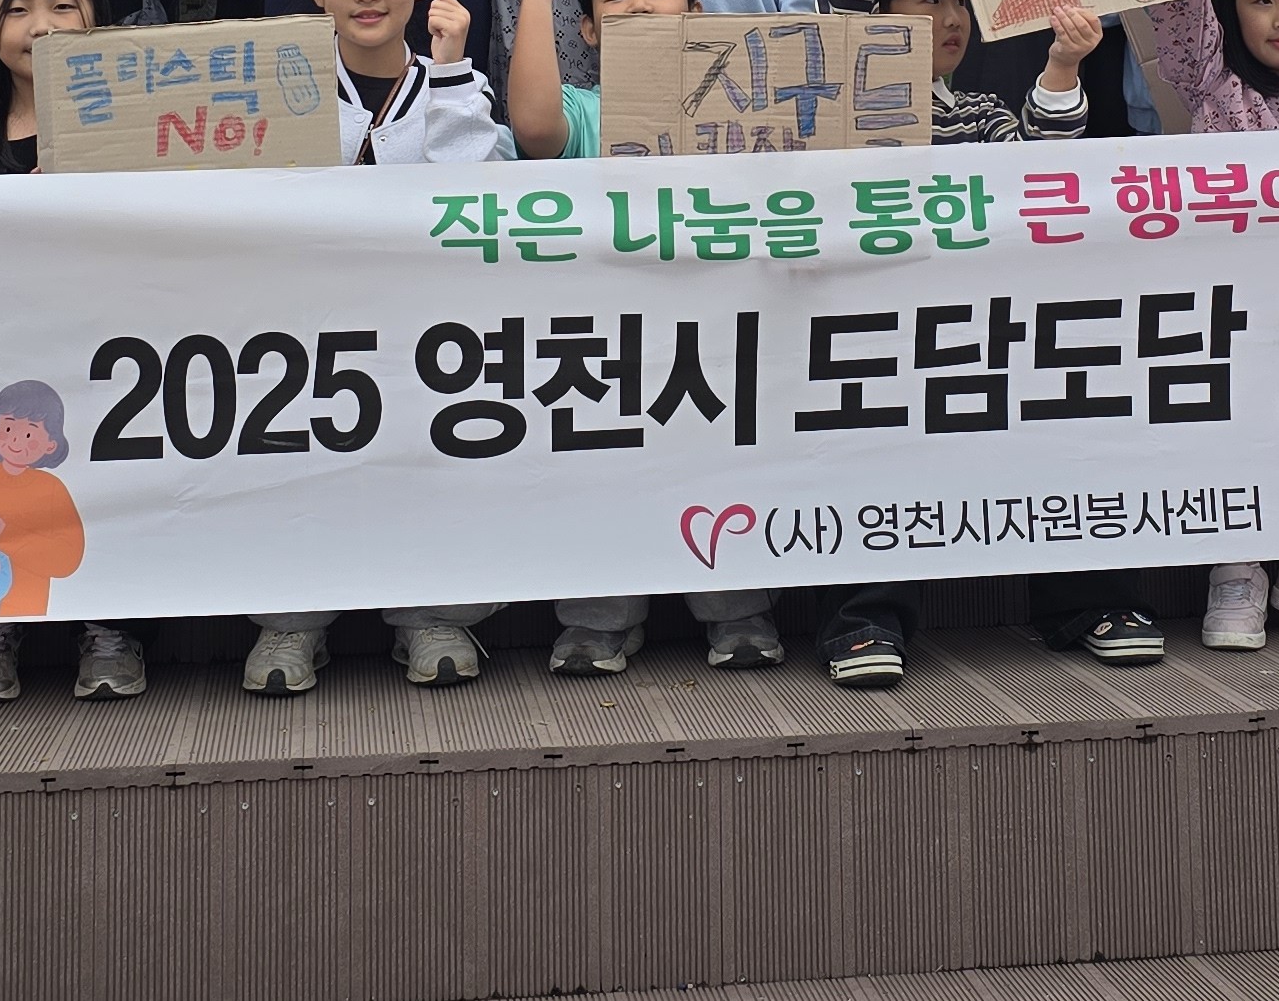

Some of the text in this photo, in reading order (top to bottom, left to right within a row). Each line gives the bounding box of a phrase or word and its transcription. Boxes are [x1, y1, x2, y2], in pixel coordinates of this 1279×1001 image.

[65, 40, 259, 126] 플라스틱
[681, 22, 919, 148] 지구를
[430, 190, 583, 264] 작은
[606, 187, 824, 262] 나눔을
[849, 174, 995, 255] 통한
[1019, 172, 1091, 245] 큰
[89, 330, 383, 462] 2025
[414, 310, 760, 460] 영천시
[794, 284, 1248, 435] 도담도담
[763, 485, 1264, 558] (사) 영천시자원봉사센터
